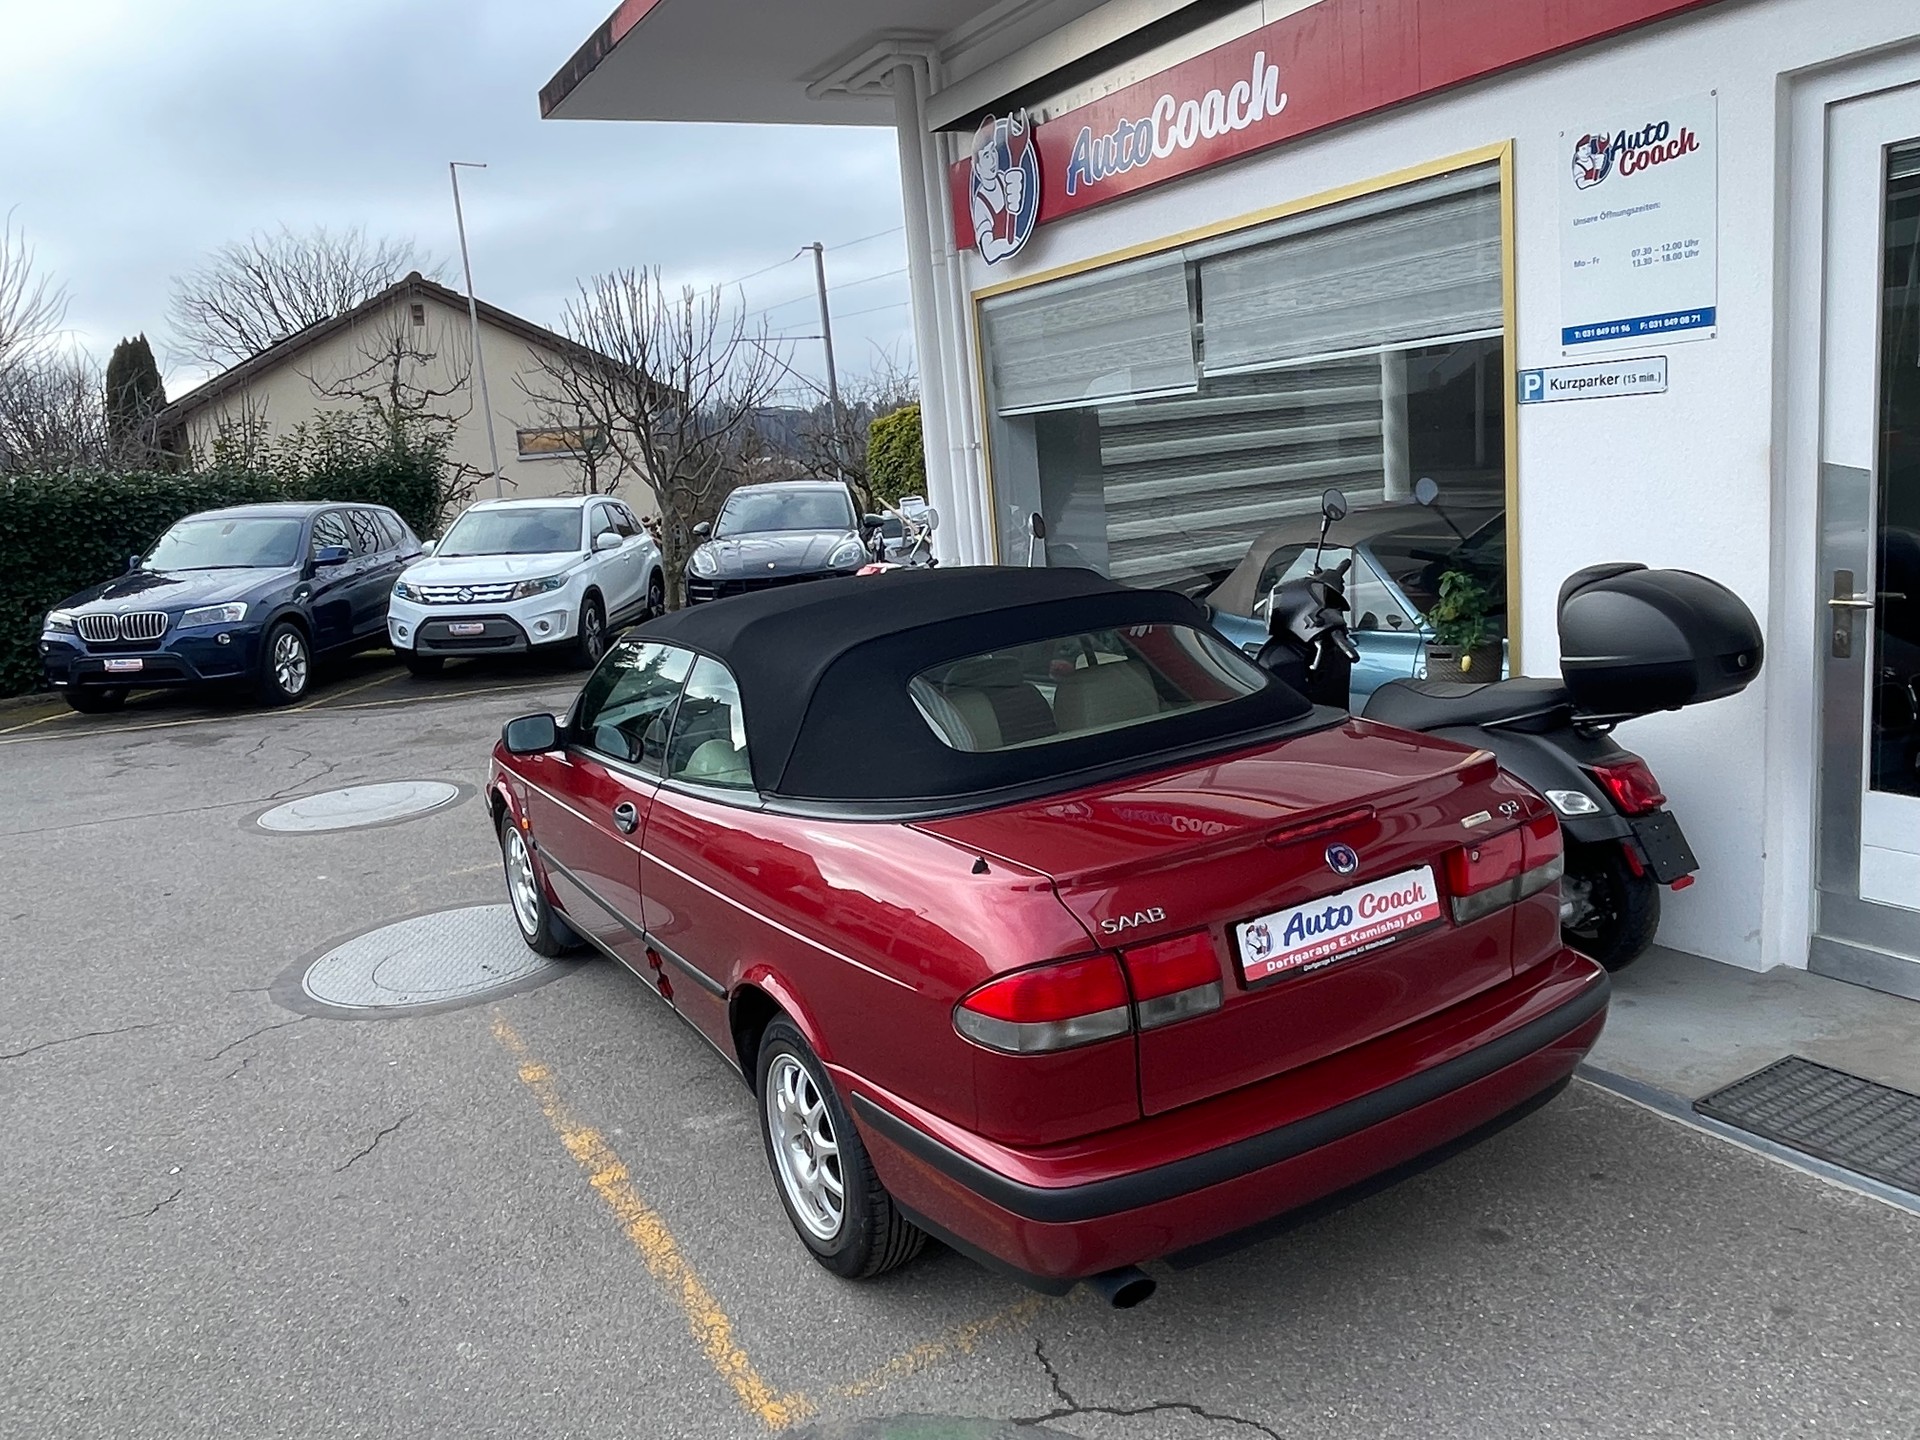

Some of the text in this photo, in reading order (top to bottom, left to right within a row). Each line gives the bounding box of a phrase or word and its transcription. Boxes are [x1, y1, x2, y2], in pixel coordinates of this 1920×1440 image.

[1609, 121, 1670, 162] Auto
[1619, 127, 1700, 177] Coach
[1573, 202, 1661, 226] Unsere Öffnungszeiten:
[1631, 246, 1652, 258] 07.30
[1661, 241, 1682, 252] 12.00
[1684, 239, 1700, 249] Uhr
[1684, 249, 1700, 259] Uhr
[1524, 371, 1662, 400] P Kurzparker (15 min.)
[1101, 907, 1167, 935] SAAB
[1283, 881, 1427, 947] Auto Coach
[1266, 942, 1338, 973] Dorfgarage
[1339, 917, 1406, 948] E.Kamishaj
